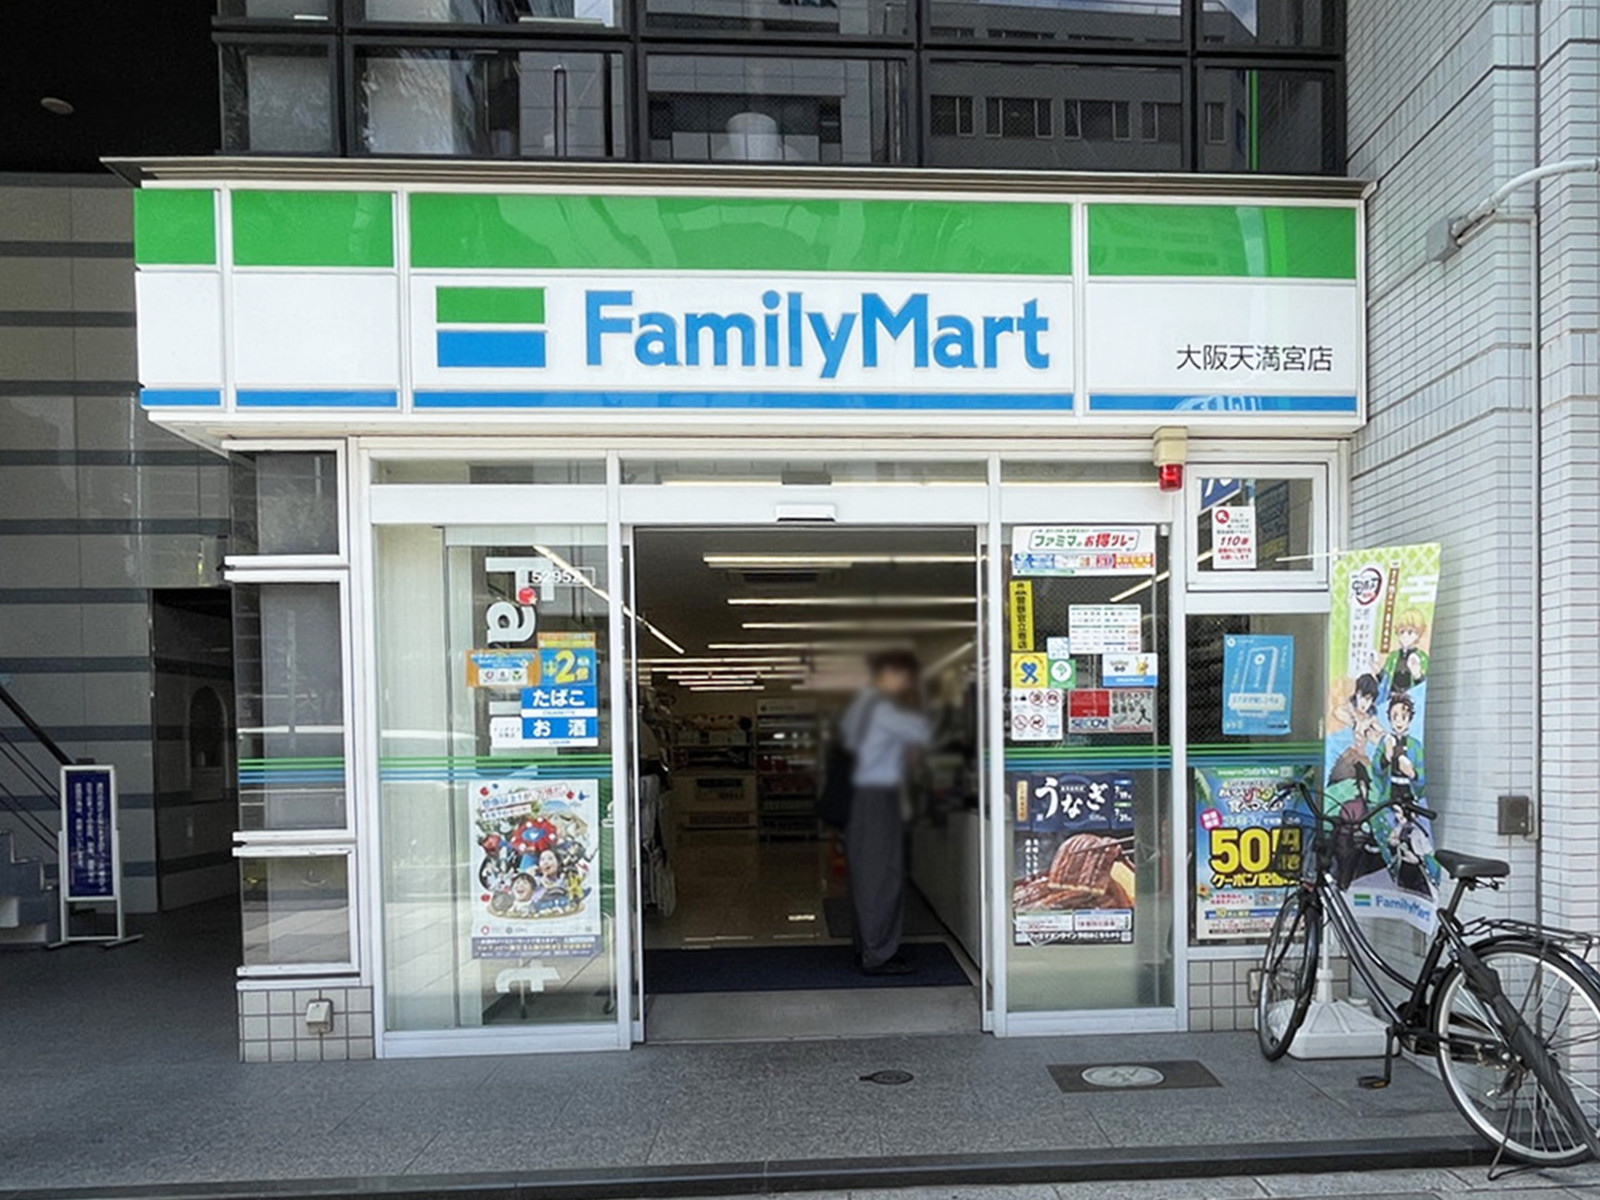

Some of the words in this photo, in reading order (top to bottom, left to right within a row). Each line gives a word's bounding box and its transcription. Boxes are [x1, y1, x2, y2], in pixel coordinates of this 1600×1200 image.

[585, 289, 1050, 379] FamilyMart
[1176, 344, 1334, 372] 大阪天満宮店
[532, 689, 586, 707] たばこ
[1035, 777, 1108, 818] うなぎ
[1375, 894, 1431, 921] FamilyMart
